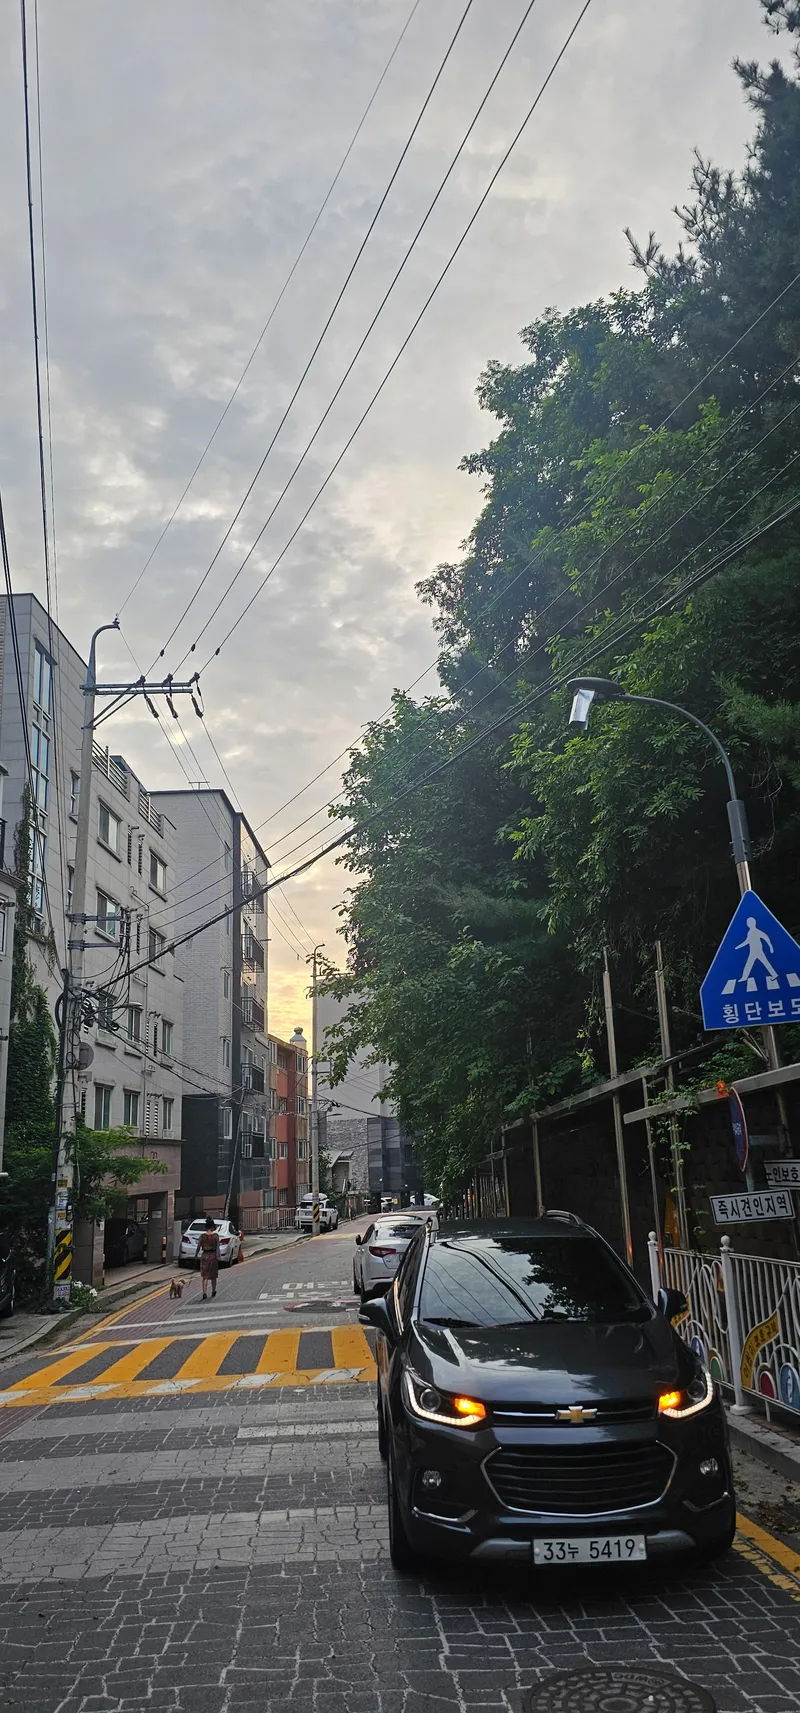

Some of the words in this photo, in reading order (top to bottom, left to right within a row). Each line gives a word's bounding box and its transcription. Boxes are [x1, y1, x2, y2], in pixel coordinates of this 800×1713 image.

[718, 1194, 788, 1219] 즉시견인지역
[543, 1542, 579, 1561] 33누
[589, 1539, 635, 1559] 5419
